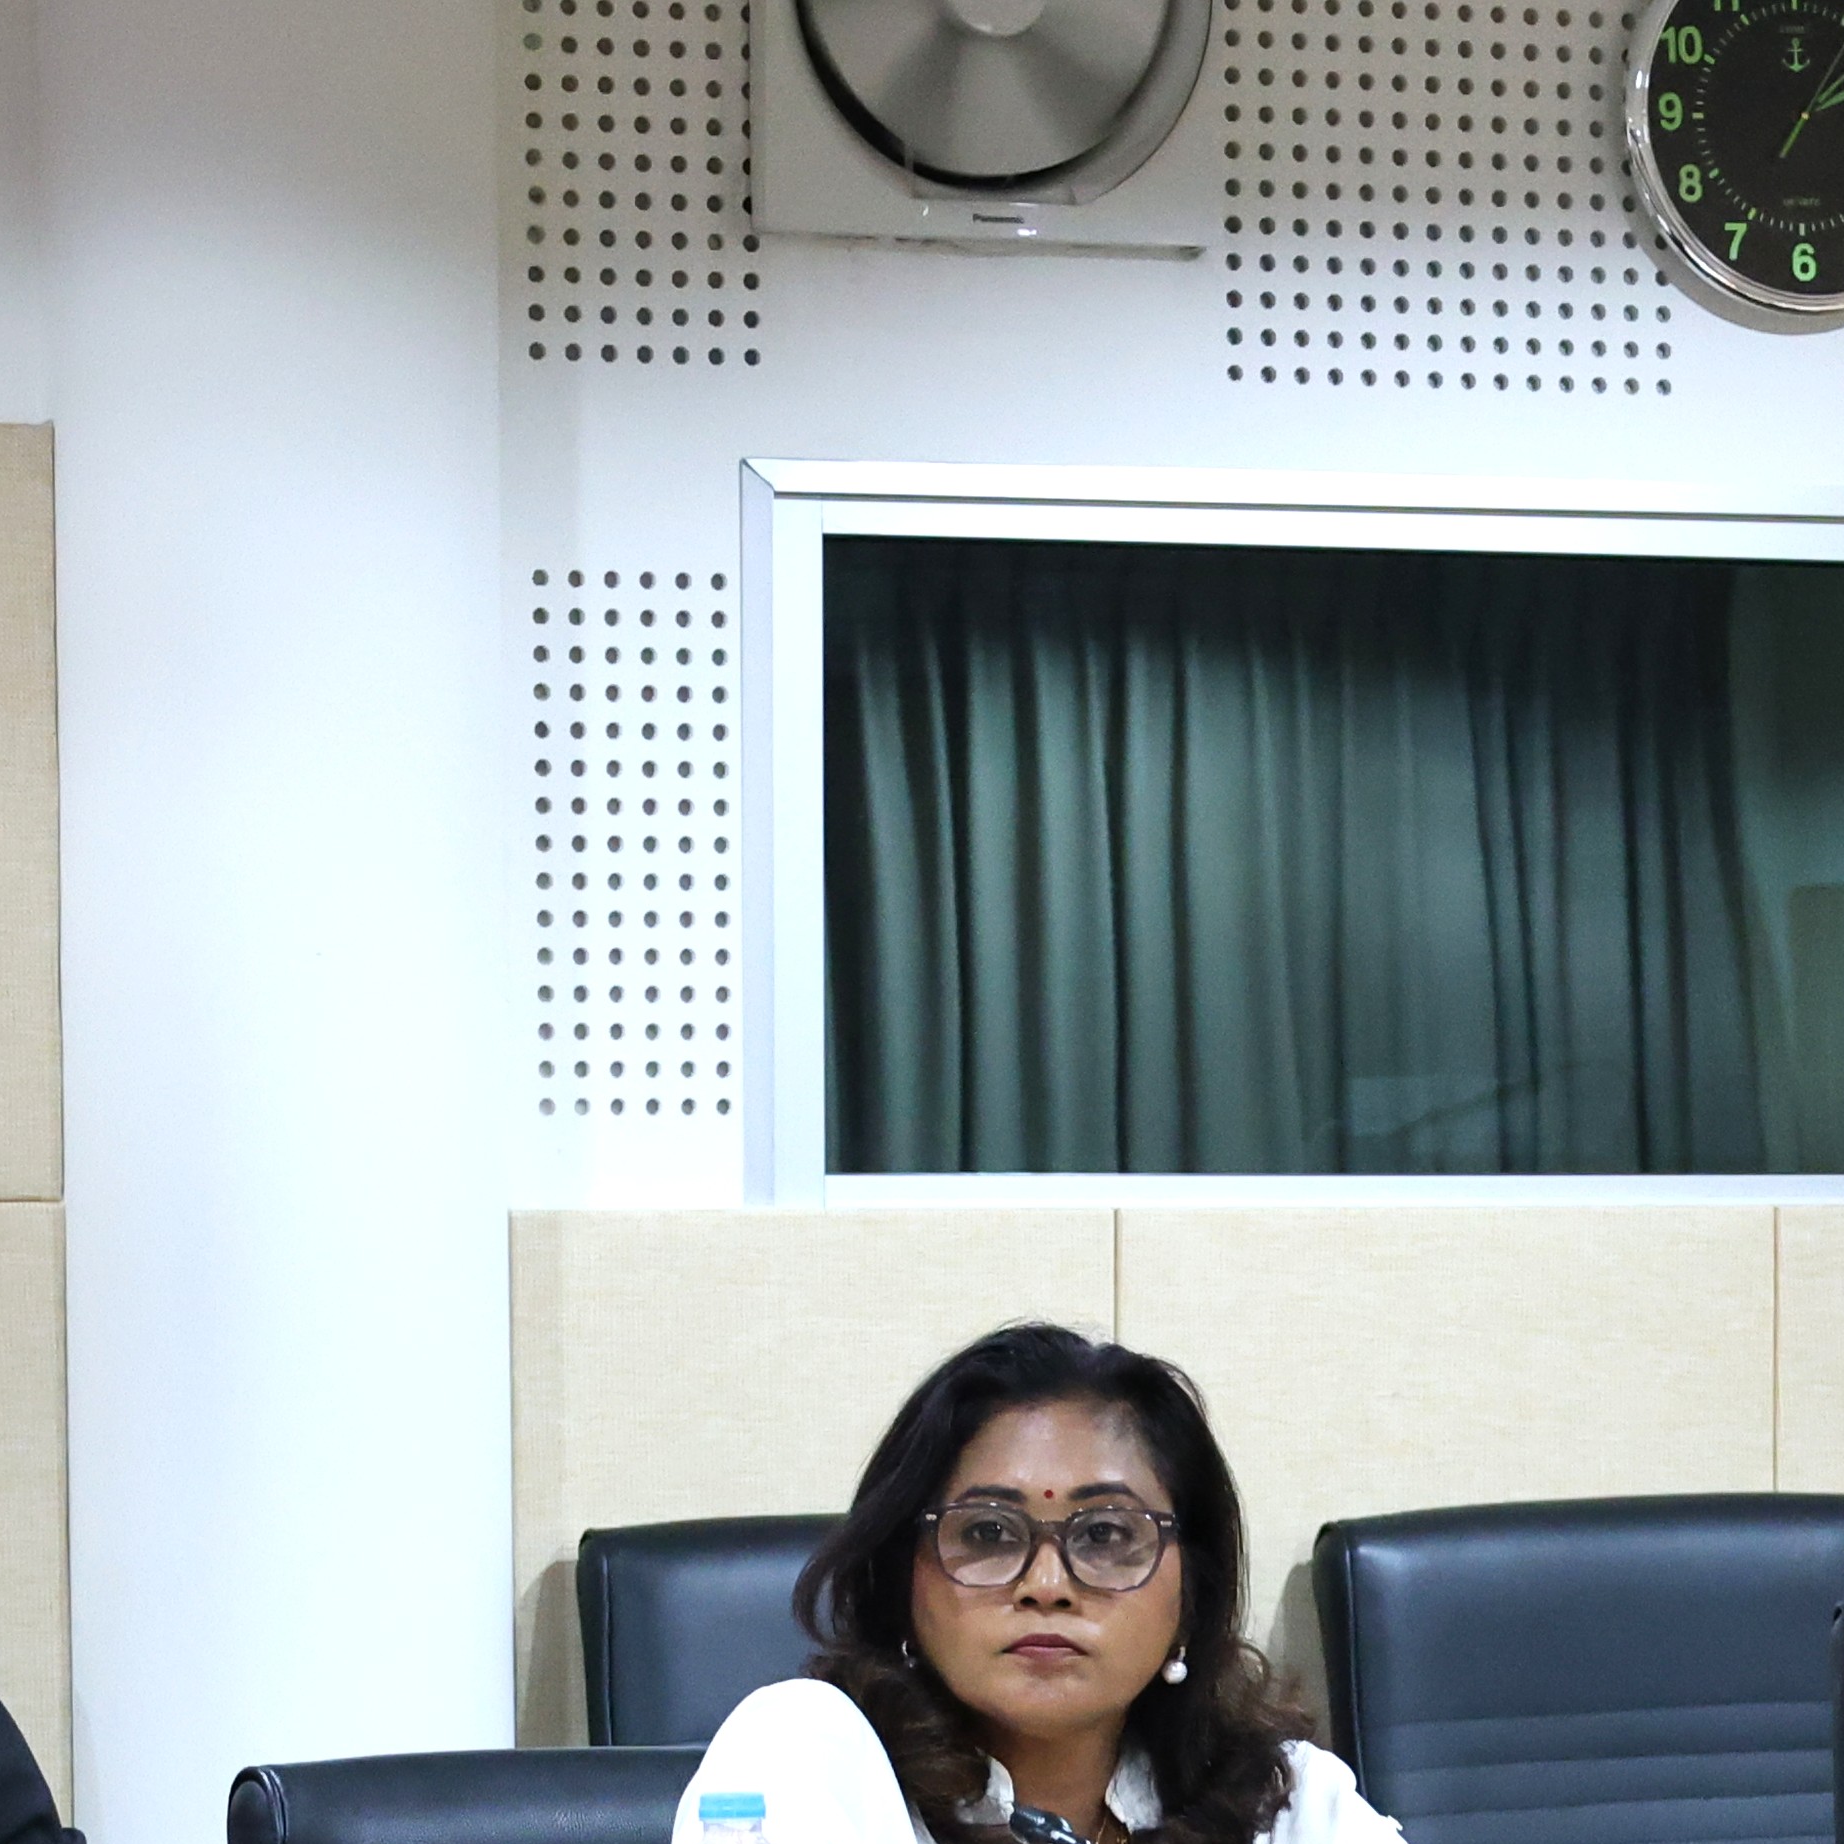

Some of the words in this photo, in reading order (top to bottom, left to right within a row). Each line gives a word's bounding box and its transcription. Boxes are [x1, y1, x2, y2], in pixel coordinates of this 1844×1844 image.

[1661, 26, 1702, 64] 10
[1659, 92, 1683, 130] 9
[1681, 165, 1702, 201] 8
[1724, 222, 1747, 260] 7
[1792, 243, 1817, 281] 6
